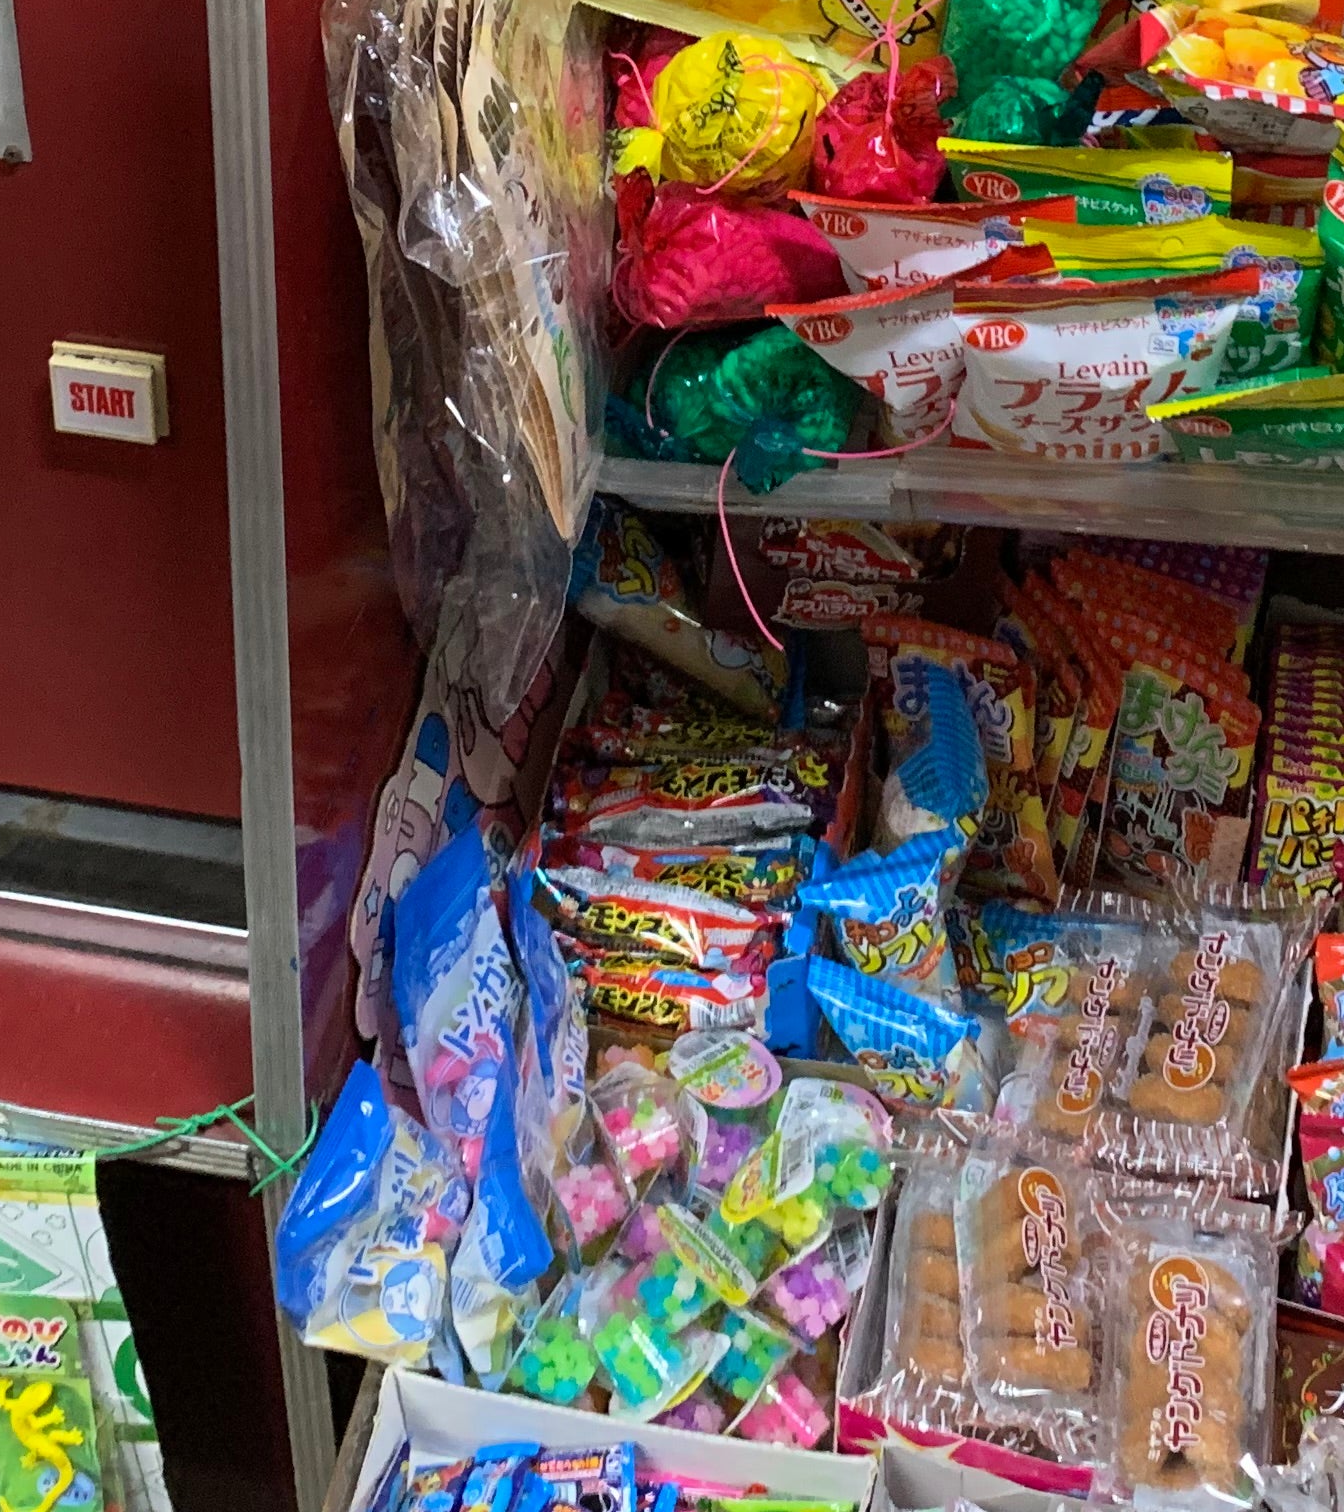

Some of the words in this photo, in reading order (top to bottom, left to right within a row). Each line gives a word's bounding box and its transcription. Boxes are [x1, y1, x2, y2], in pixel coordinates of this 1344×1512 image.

[970, 176, 1020, 202] YBC
[816, 211, 859, 237] YBC
[802, 316, 848, 343] YBC
[973, 321, 1021, 351] YBC
[1054, 314, 1151, 337] ヤマザキビスケット
[1058, 354, 1149, 381] Levain
[68, 381, 136, 421] START
